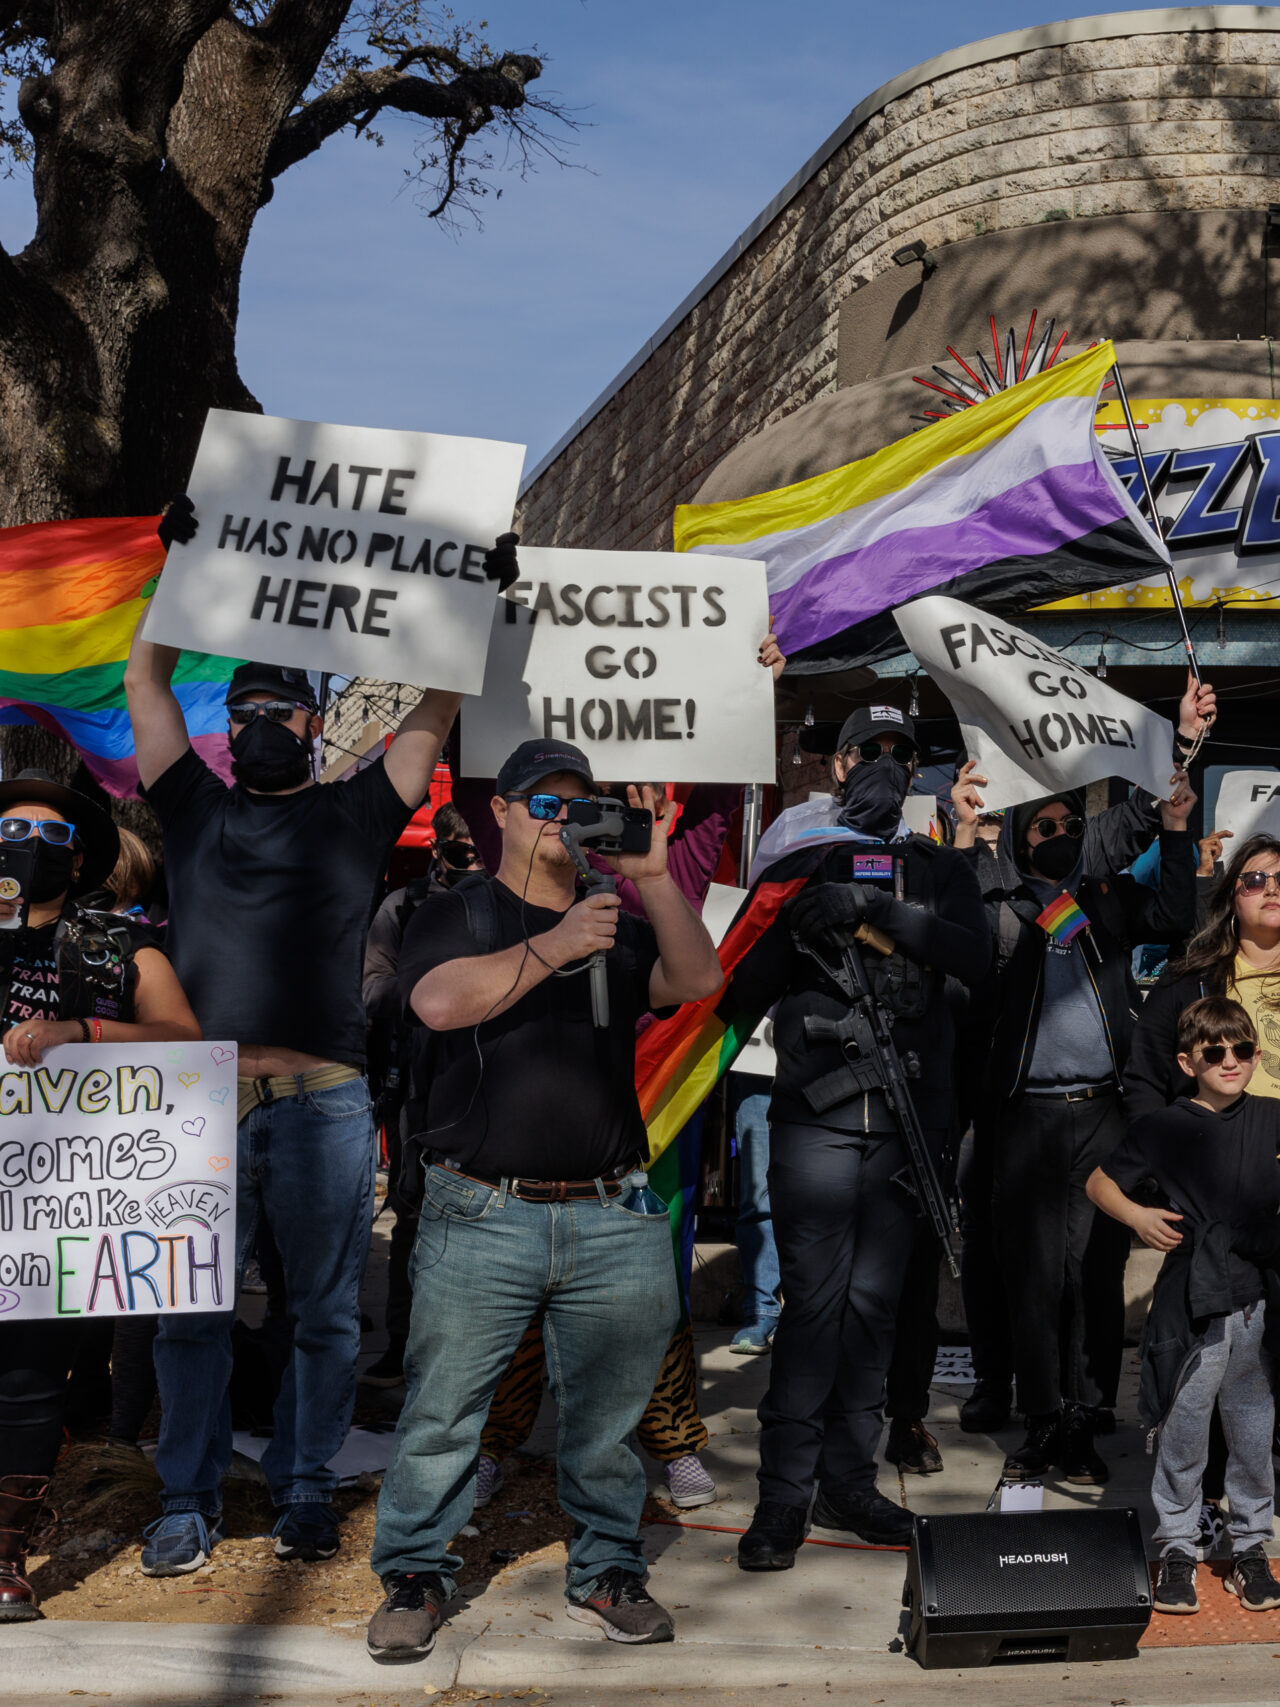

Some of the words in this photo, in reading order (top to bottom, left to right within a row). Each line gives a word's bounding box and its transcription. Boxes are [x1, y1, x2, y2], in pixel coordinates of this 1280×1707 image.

[270, 456, 416, 515] HATE
[218, 514, 292, 558] HAS
[297, 525, 358, 564] NO
[364, 532, 490, 583] PLACE
[250, 575, 398, 637] HERE
[505, 581, 727, 628] FASCISTS
[585, 645, 657, 680] GO
[1028, 670, 1087, 700] GO
[543, 696, 696, 741] HOME!
[1009, 712, 1136, 760] HOME!
[0, 1129, 176, 1187] comes
[23, 1188, 143, 1231] make
[144, 1188, 231, 1228] HEAVEN
[0, 1252, 50, 1288] on
[56, 1230, 223, 1315] EARTH
